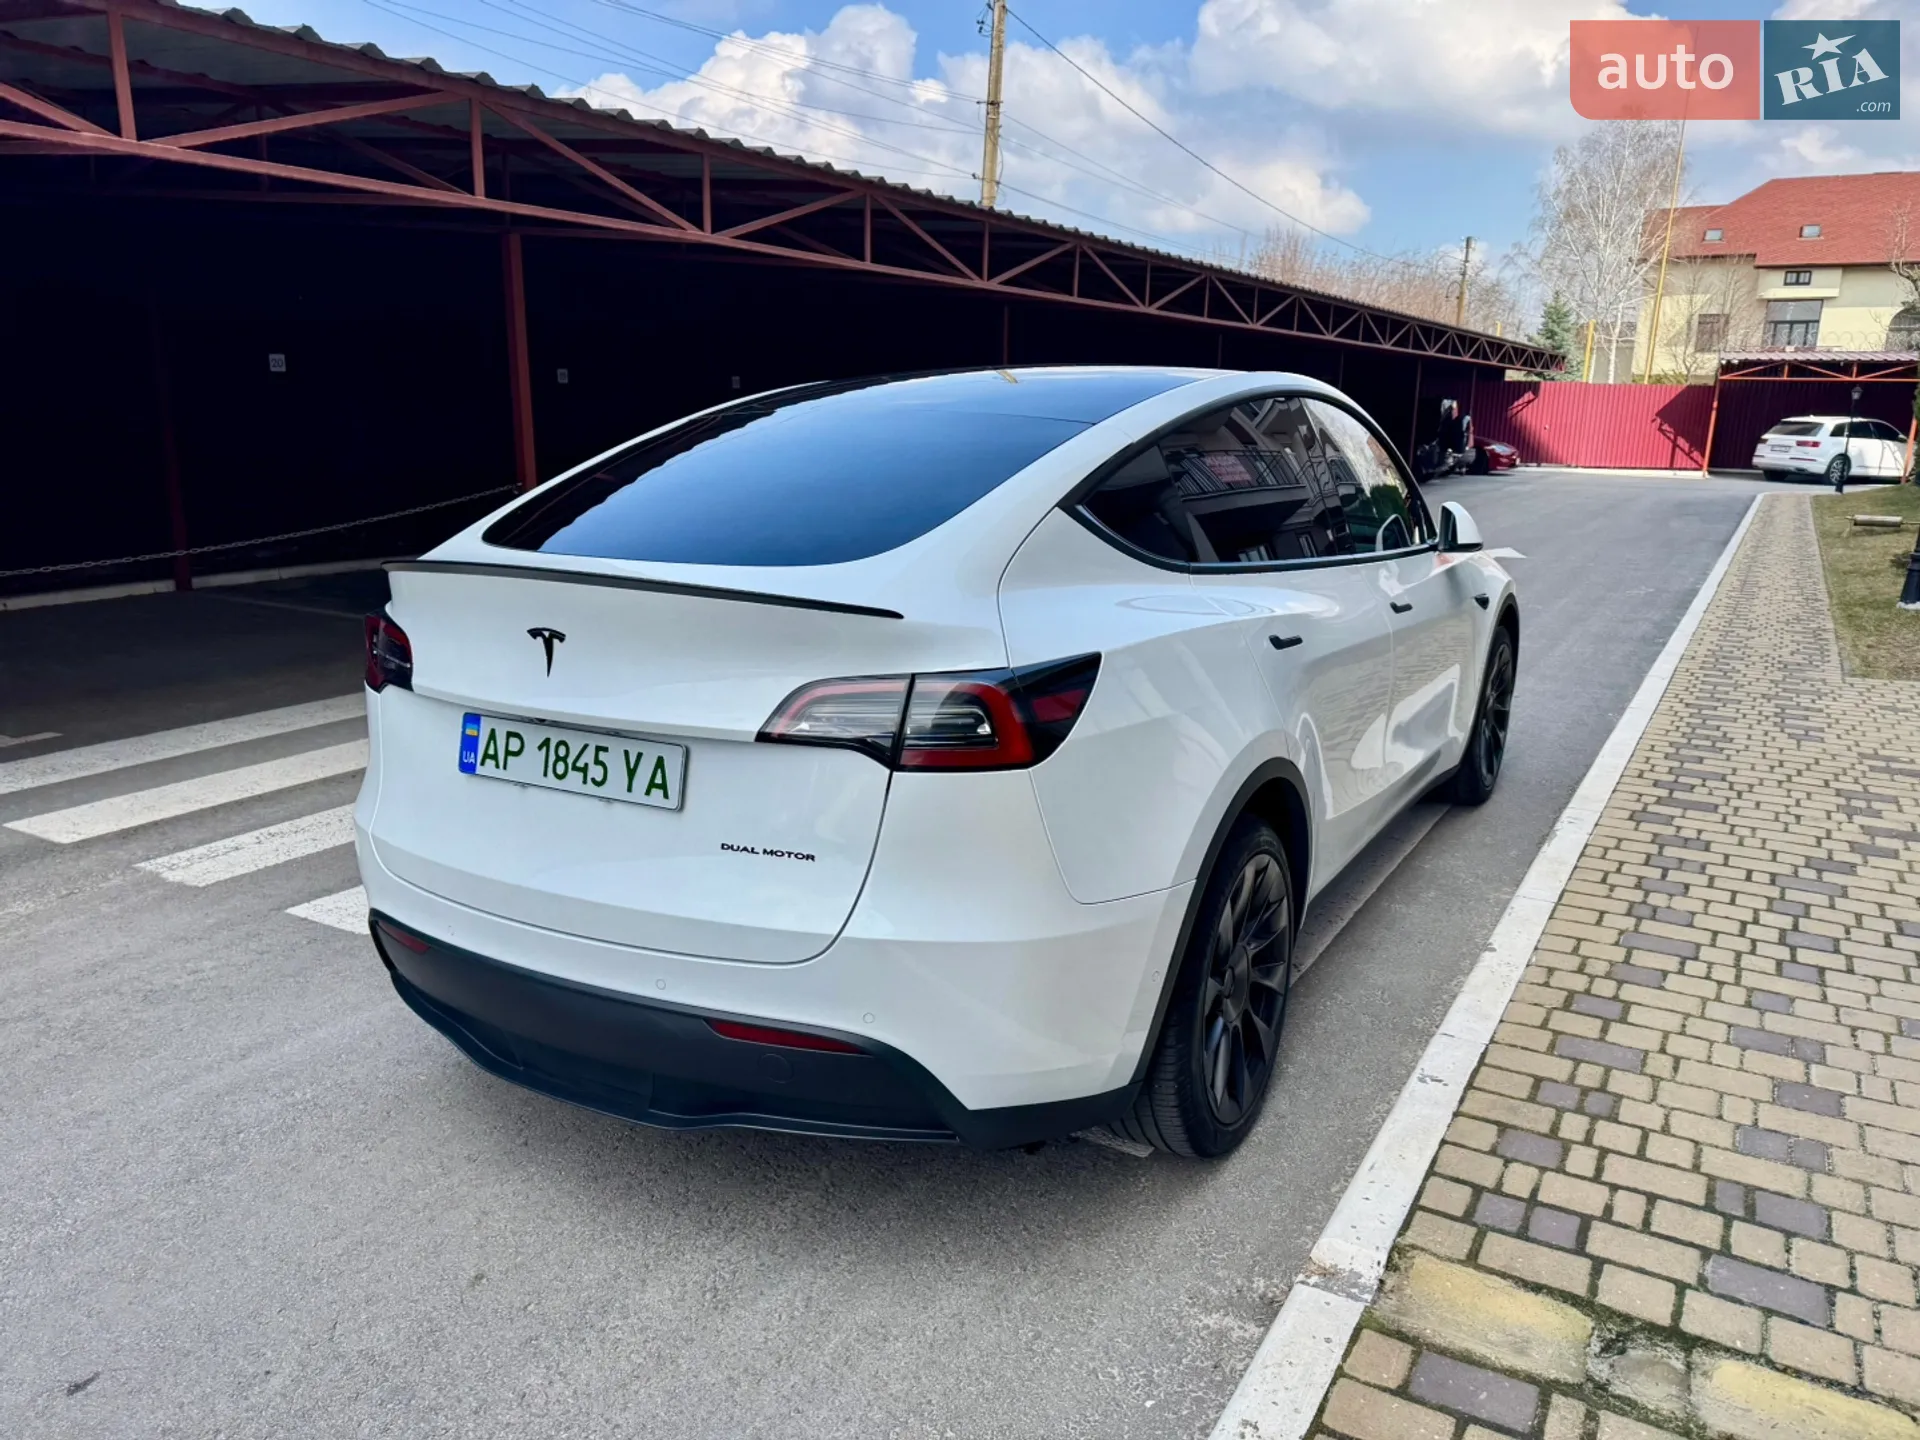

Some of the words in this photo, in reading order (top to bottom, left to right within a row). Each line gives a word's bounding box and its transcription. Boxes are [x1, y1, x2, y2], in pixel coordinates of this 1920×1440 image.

[462, 750, 476, 764] UA
[480, 728, 525, 770] AP
[537, 737, 609, 788] 1845
[623, 750, 669, 800] YA
[721, 843, 760, 855] DUAL
[762, 848, 816, 862] MOTOR
